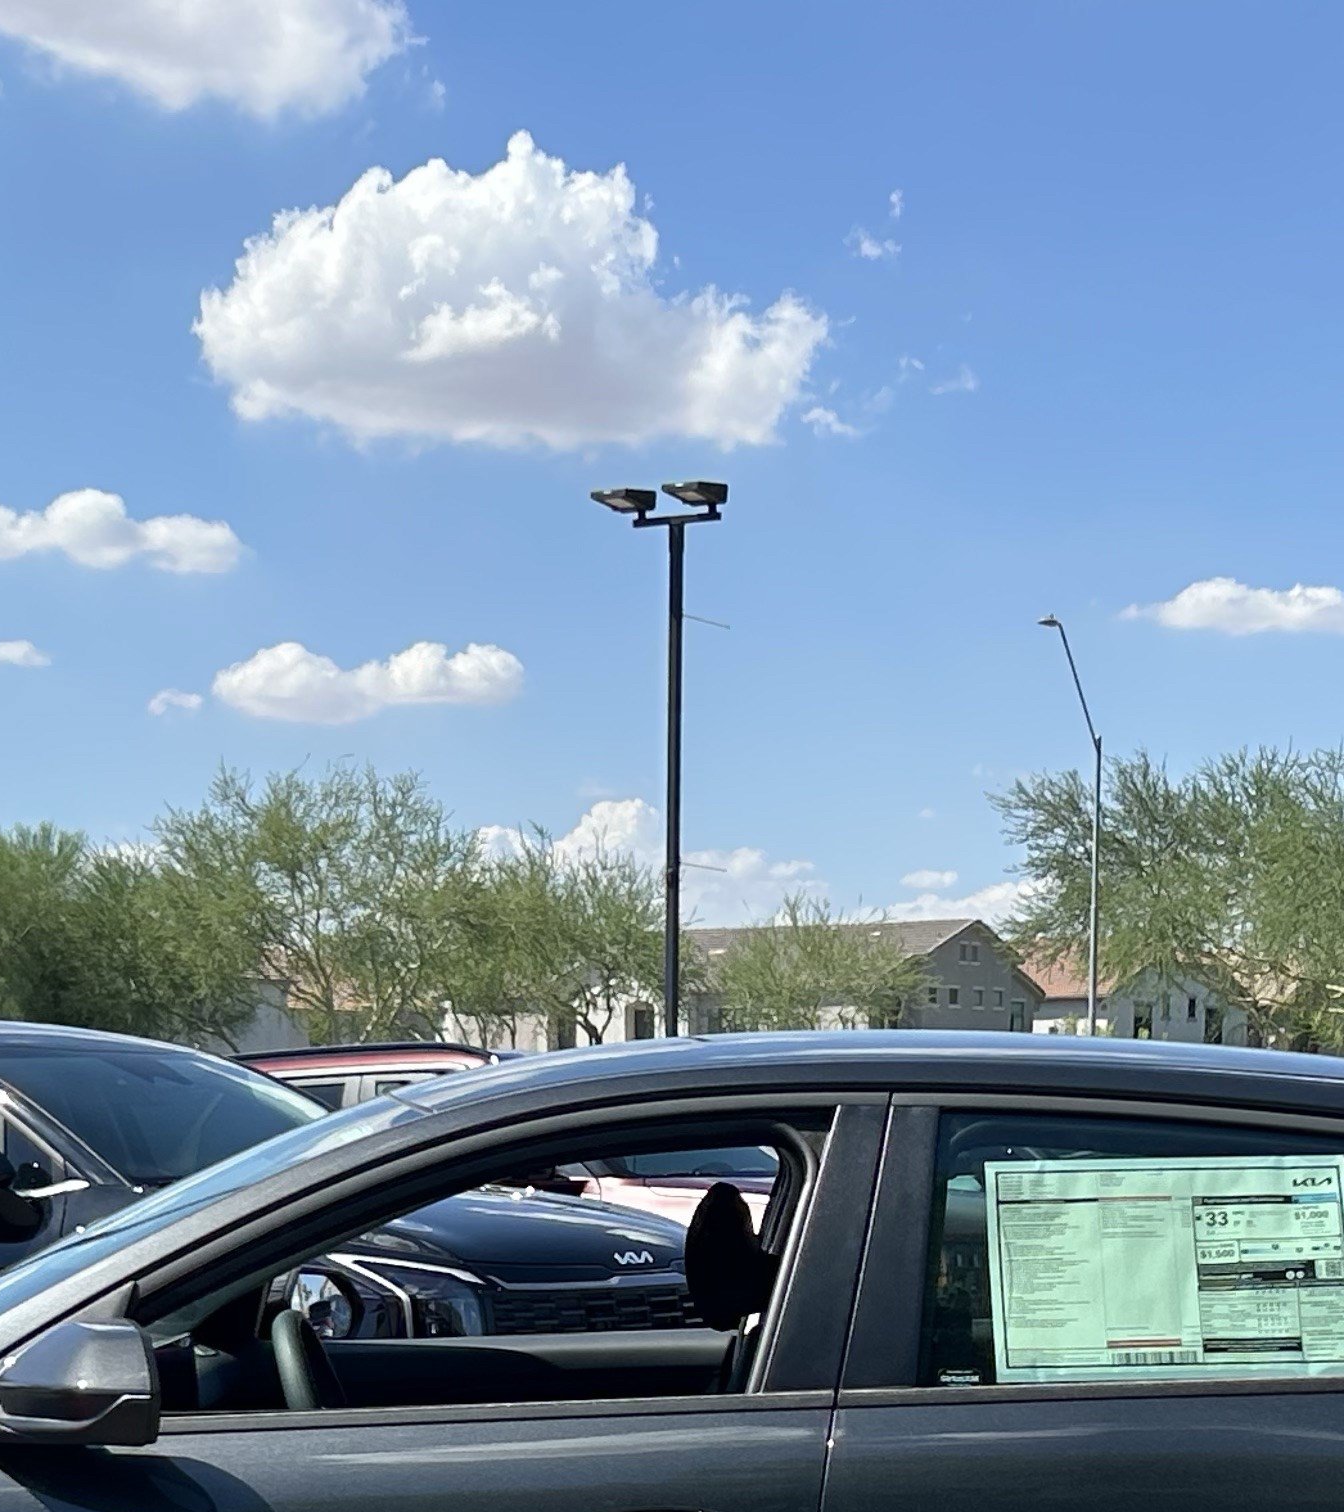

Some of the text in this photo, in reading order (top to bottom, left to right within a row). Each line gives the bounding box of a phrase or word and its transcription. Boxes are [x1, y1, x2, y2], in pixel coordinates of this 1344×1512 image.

[1292, 1177, 1333, 1188] KIA
[1206, 1211, 1229, 1227] 33
[613, 1250, 654, 1265] KIA
